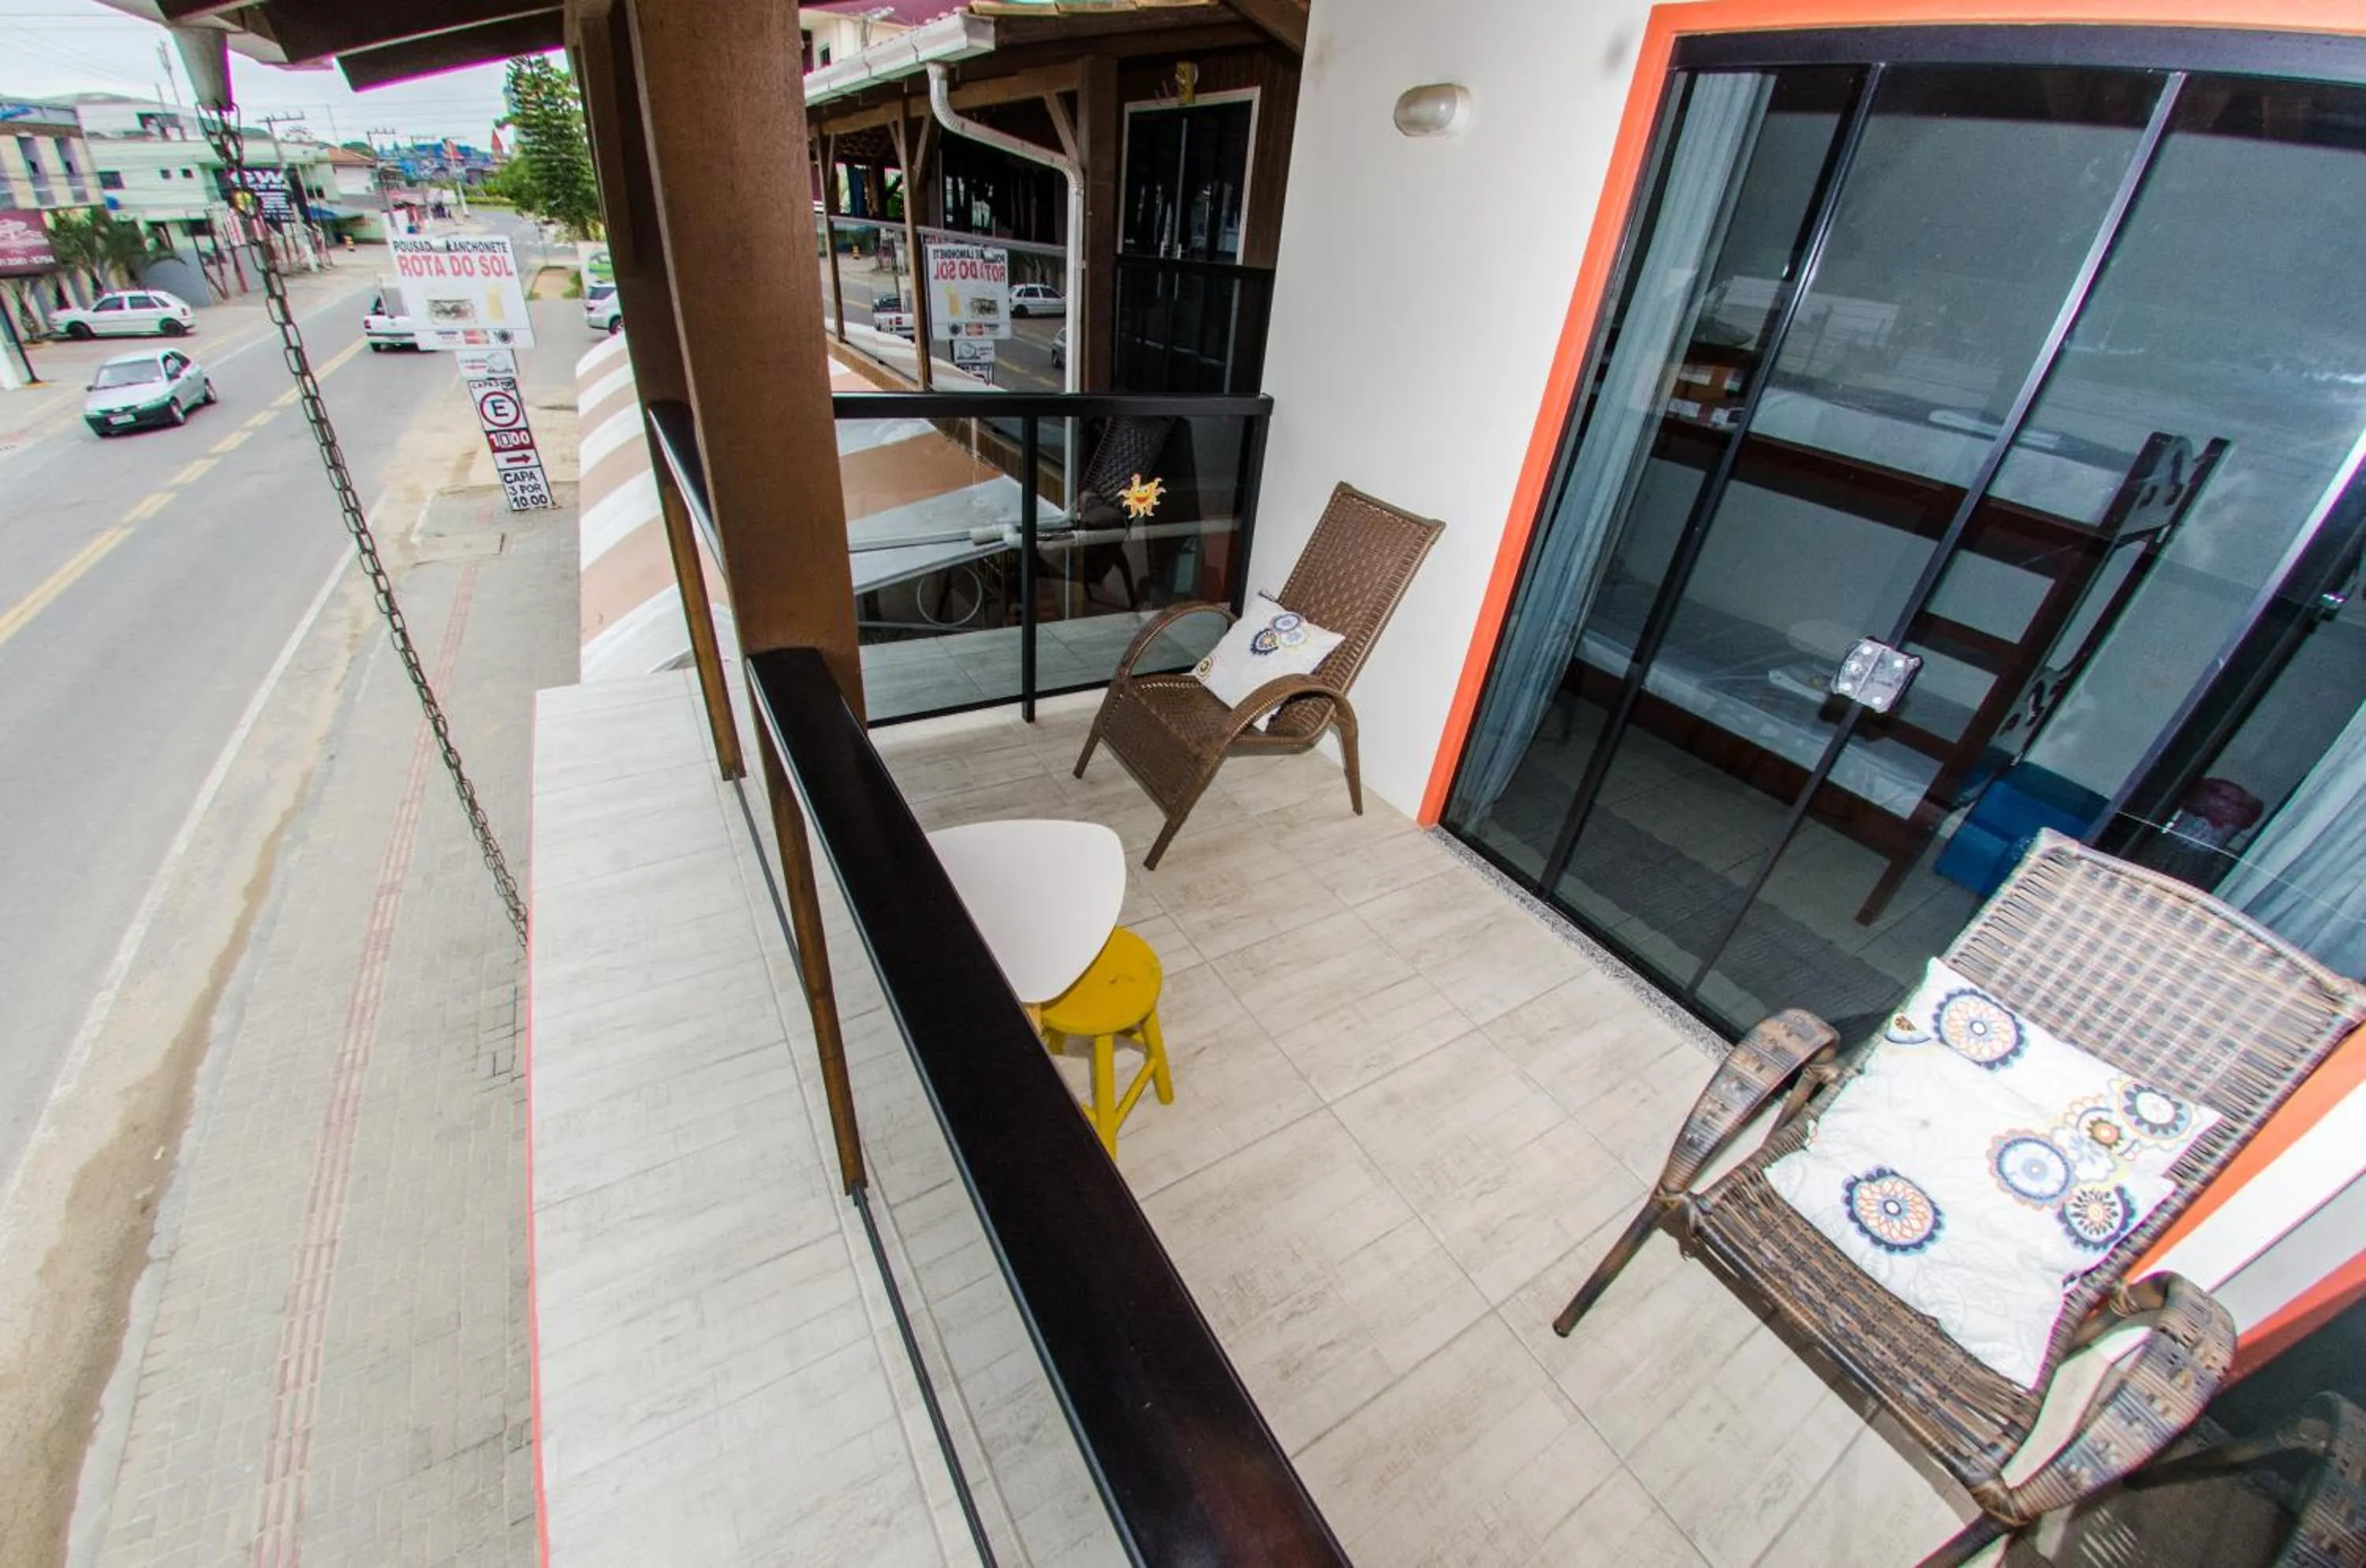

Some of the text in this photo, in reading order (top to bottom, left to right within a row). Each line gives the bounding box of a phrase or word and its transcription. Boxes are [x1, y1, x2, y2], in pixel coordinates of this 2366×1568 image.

[392, 241, 434, 252] POUSAD
[397, 254, 513, 278] ROTA DO SOL
[490, 399, 509, 417] E
[502, 472, 538, 484] CAPA
[509, 483, 543, 496] 3 POR
